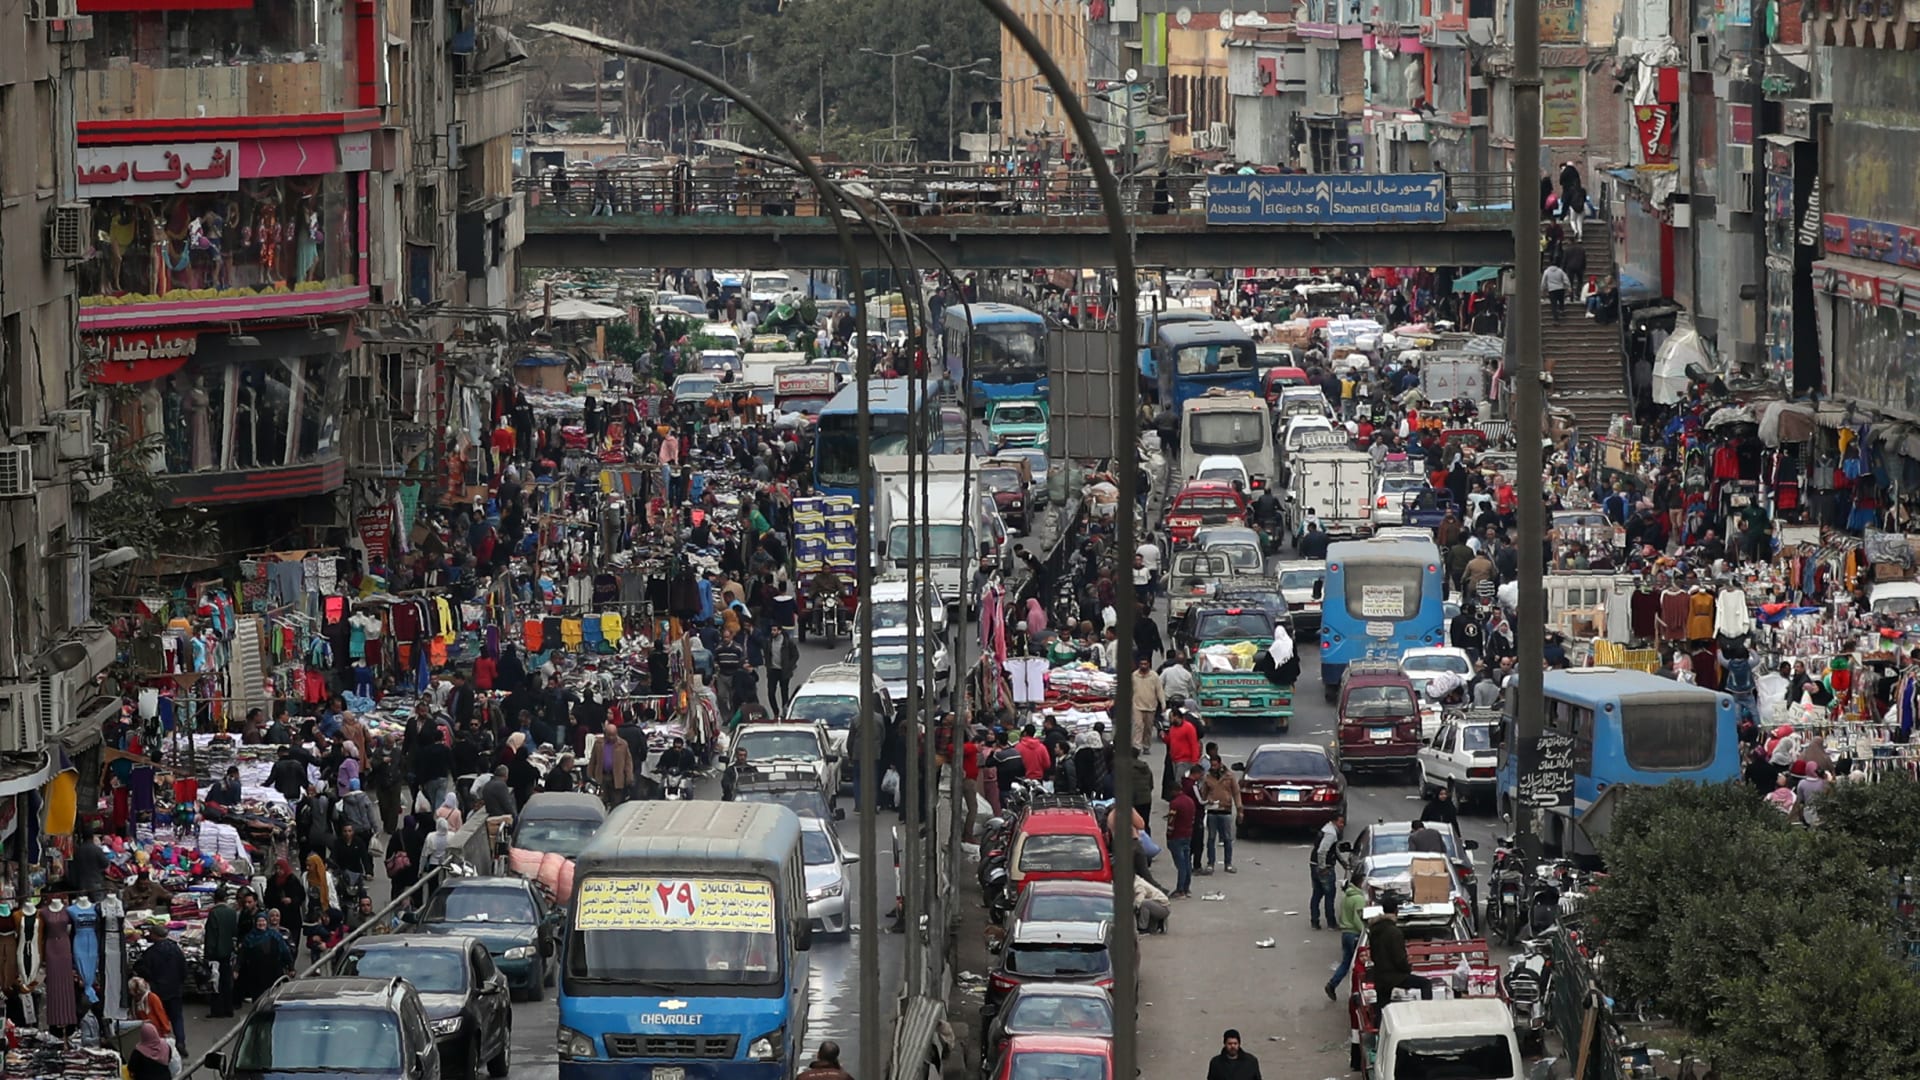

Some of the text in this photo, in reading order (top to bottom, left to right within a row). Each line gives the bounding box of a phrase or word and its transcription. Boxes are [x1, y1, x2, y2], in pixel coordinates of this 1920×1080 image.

[1210, 181, 1247, 195] العباسية
[1264, 181, 1315, 196] ميدان الجيش
[1334, 180, 1422, 196] محور شمال الجمالية
[1209, 203, 1251, 214] Abbasia
[1265, 203, 1275, 214] El
[1333, 202, 1369, 213] Shamal
[1370, 203, 1380, 213] El
[1380, 202, 1421, 213] Gamalia
[656, 882, 695, 915] ٢٩
[641, 1014, 704, 1025] CHEVROLET
